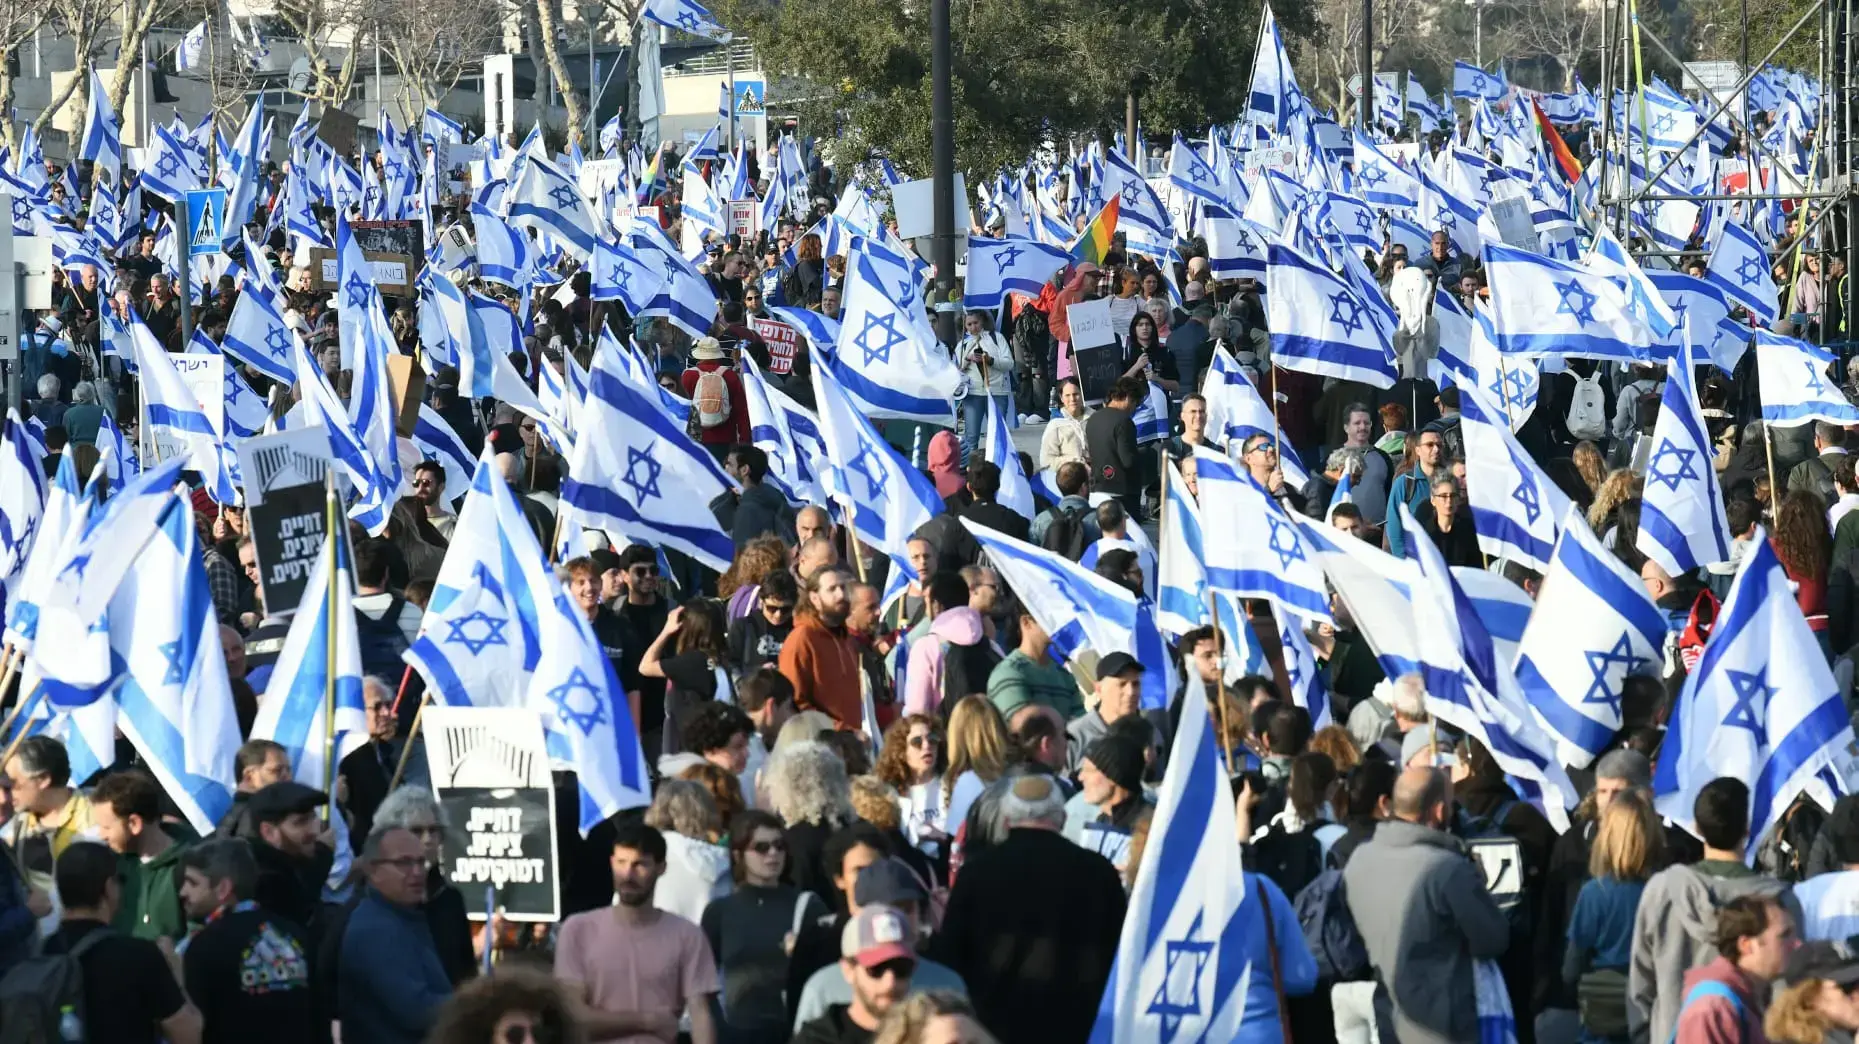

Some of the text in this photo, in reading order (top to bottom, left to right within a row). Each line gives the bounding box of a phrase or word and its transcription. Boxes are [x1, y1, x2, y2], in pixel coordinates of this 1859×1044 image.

[754, 322, 797, 343] הרופא
[764, 340, 794, 357] נלחמי
[169, 358, 208, 373] ישרא
[770, 356, 793, 370] הדמ
[279, 513, 322, 540] דתיים.
[269, 555, 318, 585] רטים.
